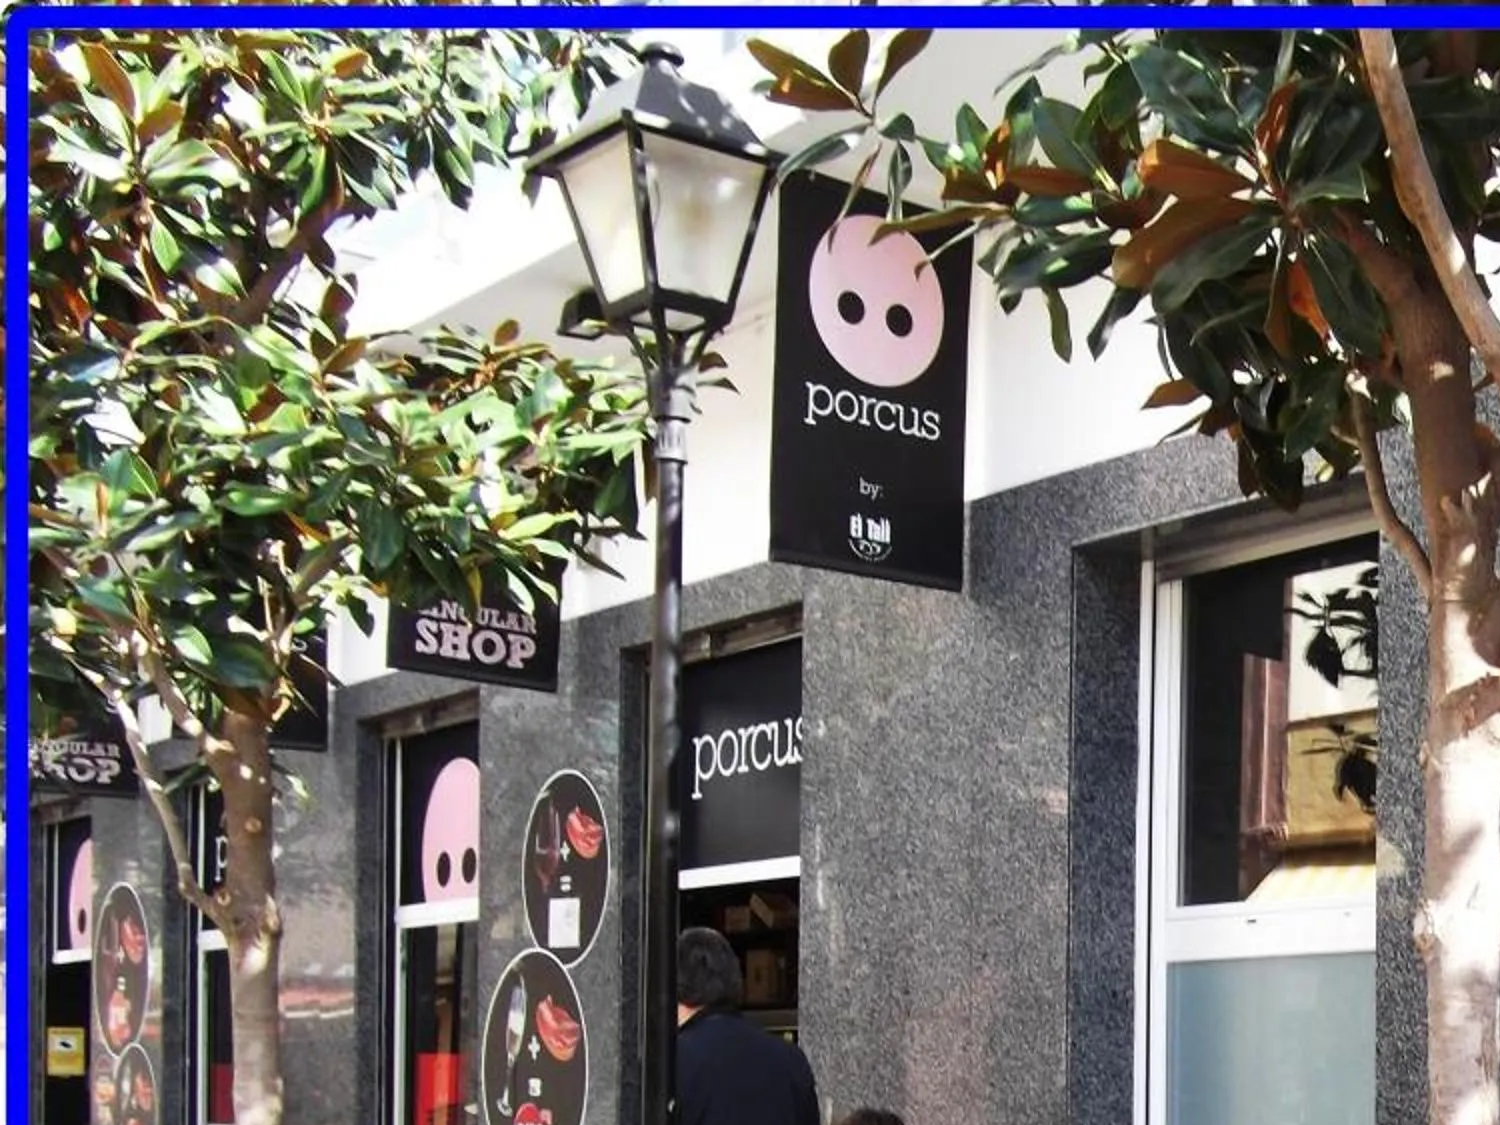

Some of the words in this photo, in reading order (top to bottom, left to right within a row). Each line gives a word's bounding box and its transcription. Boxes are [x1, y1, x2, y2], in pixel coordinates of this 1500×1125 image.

[803, 380, 941, 441] porcus
[859, 476, 885, 502] by:
[415, 617, 537, 669] SHOP
